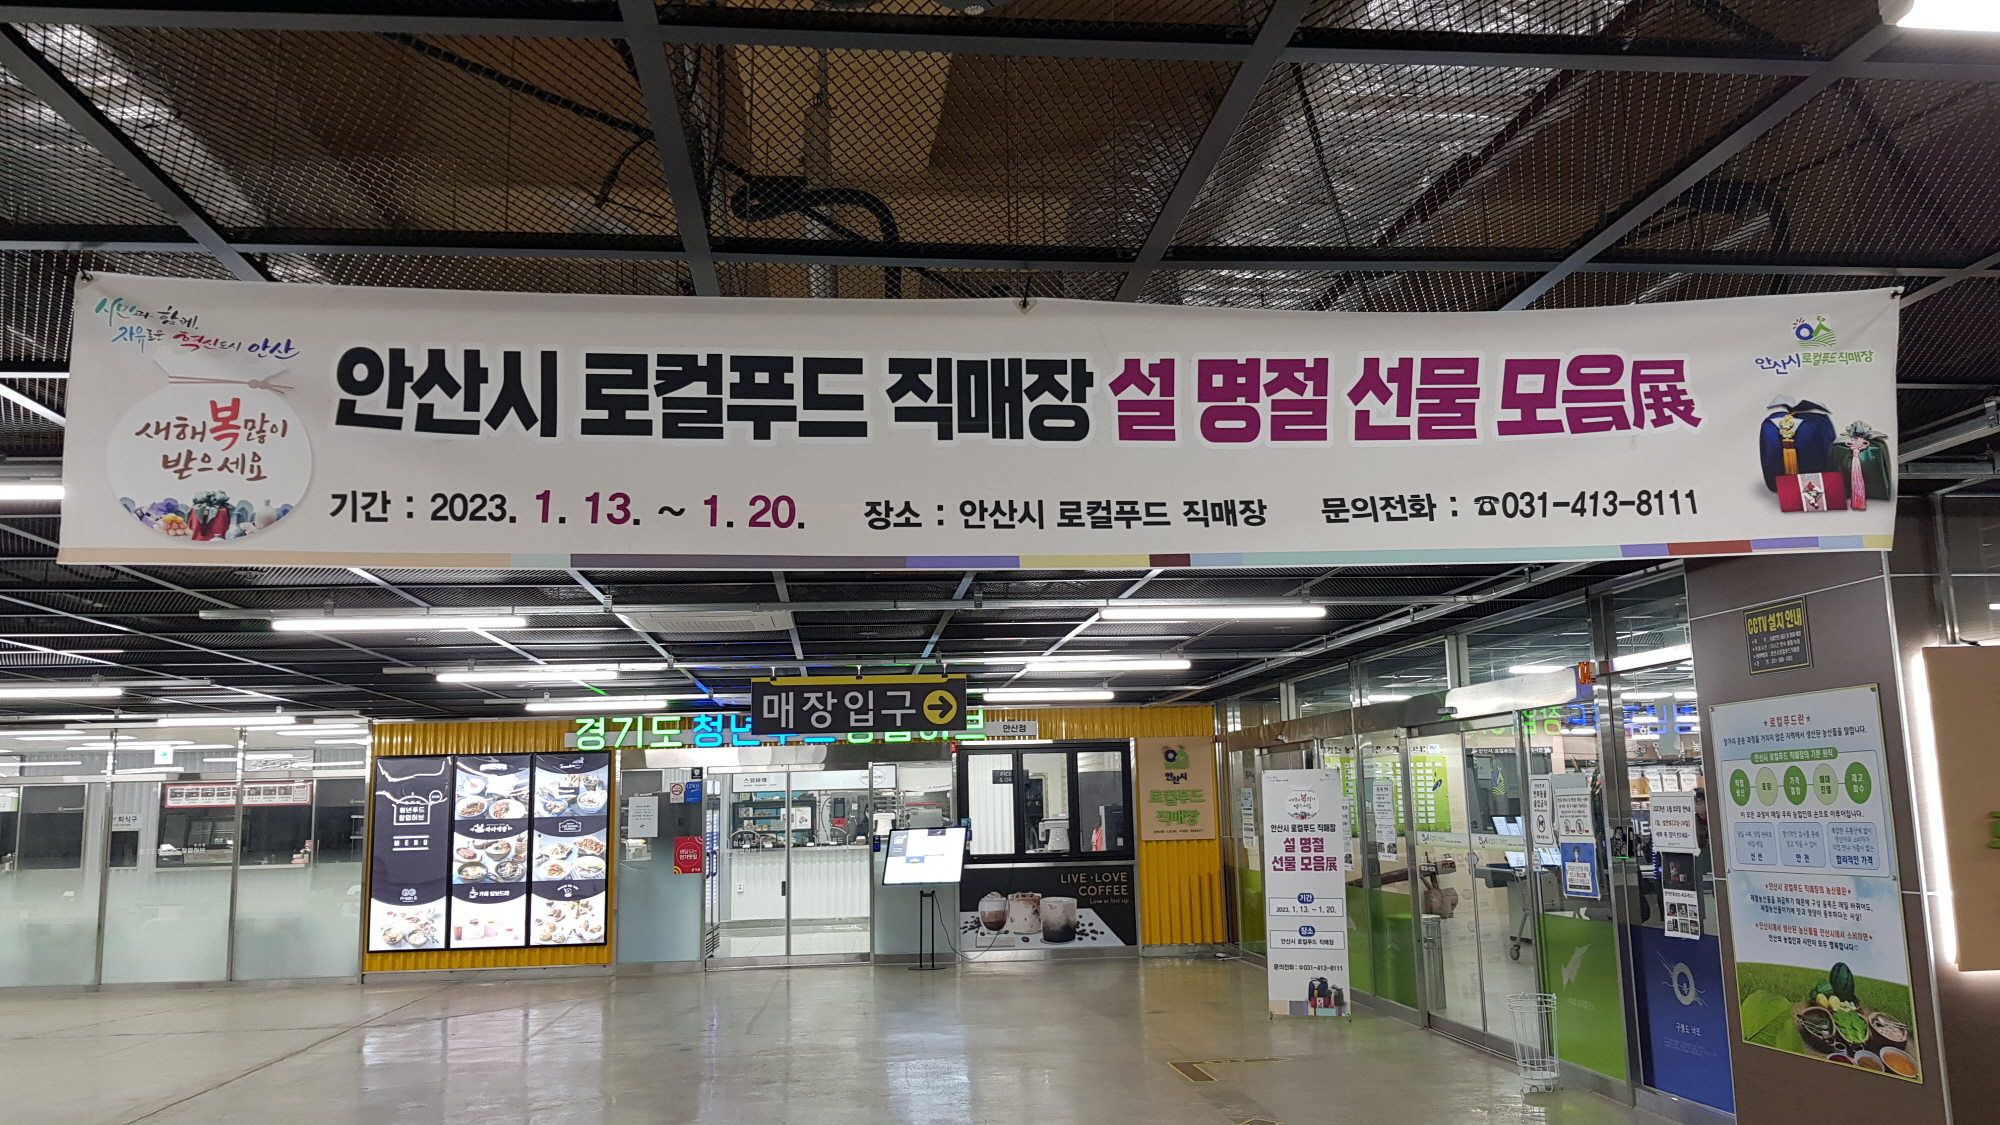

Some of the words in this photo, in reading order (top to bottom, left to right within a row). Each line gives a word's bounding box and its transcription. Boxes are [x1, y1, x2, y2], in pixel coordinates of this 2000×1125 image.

[95, 298, 154, 327] 시민과
[111, 326, 166, 354] 자유로운
[172, 331, 242, 352] 혁신도시
[247, 338, 300, 360] 안산
[336, 346, 558, 438] 안산시
[580, 352, 868, 441] 로컬푸드
[885, 356, 1094, 442] 직매장
[1109, 357, 1176, 442] 설
[1198, 357, 1329, 444] 명절
[1347, 356, 1481, 442] 선물
[1497, 353, 1703, 438] 모음展
[135, 414, 206, 446] 새해
[208, 397, 242, 452] 복
[244, 416, 289, 446] 많이
[162, 450, 268, 482] 받으세요
[330, 490, 392, 524] 기간
[430, 493, 517, 524] 2023.
[536, 490, 567, 524] 1.
[586, 492, 642, 526] 13.
[704, 495, 734, 528] 1.
[749, 495, 805, 530] 20.
[864, 500, 923, 529] 장소
[959, 500, 1044, 530] 안산시
[1056, 500, 1171, 529] 로컬푸드
[1181, 498, 1268, 530] 직매장
[1321, 492, 1436, 525] 문의전화
[1748, 616, 1768, 634] CCTV
[1768, 612, 1784, 632] 설치
[1785, 608, 1802, 628] 안내
[762, 690, 917, 729] 매장입구
[1770, 714, 1804, 727] 로컬푸드란
[575, 714, 684, 751] 경기도
[1002, 724, 1027, 734] 안산점
[1786, 732, 1804, 740] 지역에서
[1806, 730, 1821, 739] 생산된
[1822, 728, 1842, 737] 농산물을
[1754, 754, 1768, 762] 안산시
[1770, 752, 1788, 761] 로컬푸드
[1811, 750, 1821, 758] 기본
[1165, 772, 1188, 784] 안산시
[1789, 776, 1800, 785] 가격
[1852, 774, 1864, 782] 재고
[1148, 788, 1206, 806] 로컬푸드
[1156, 810, 1200, 826] 직매장
[1270, 824, 1290, 832] 안산시
[1291, 824, 1316, 832] 로컬푸드
[1317, 824, 1336, 832] 직매장
[1284, 837, 1296, 853] 설
[1300, 837, 1324, 853] 명절
[1272, 856, 1296, 872] 선물
[1300, 856, 1338, 872] 모음展
[1836, 855, 1860, 864] 합리적인
[1861, 856, 1873, 865] 가격
[1060, 873, 1086, 884] LIVE
[1078, 885, 1128, 896] COFFEE
[1768, 882, 1782, 891] 안산시
[1784, 884, 1802, 892] 로컬푸드
[1300, 894, 1312, 902] 기간
[1300, 927, 1314, 935] 장소
